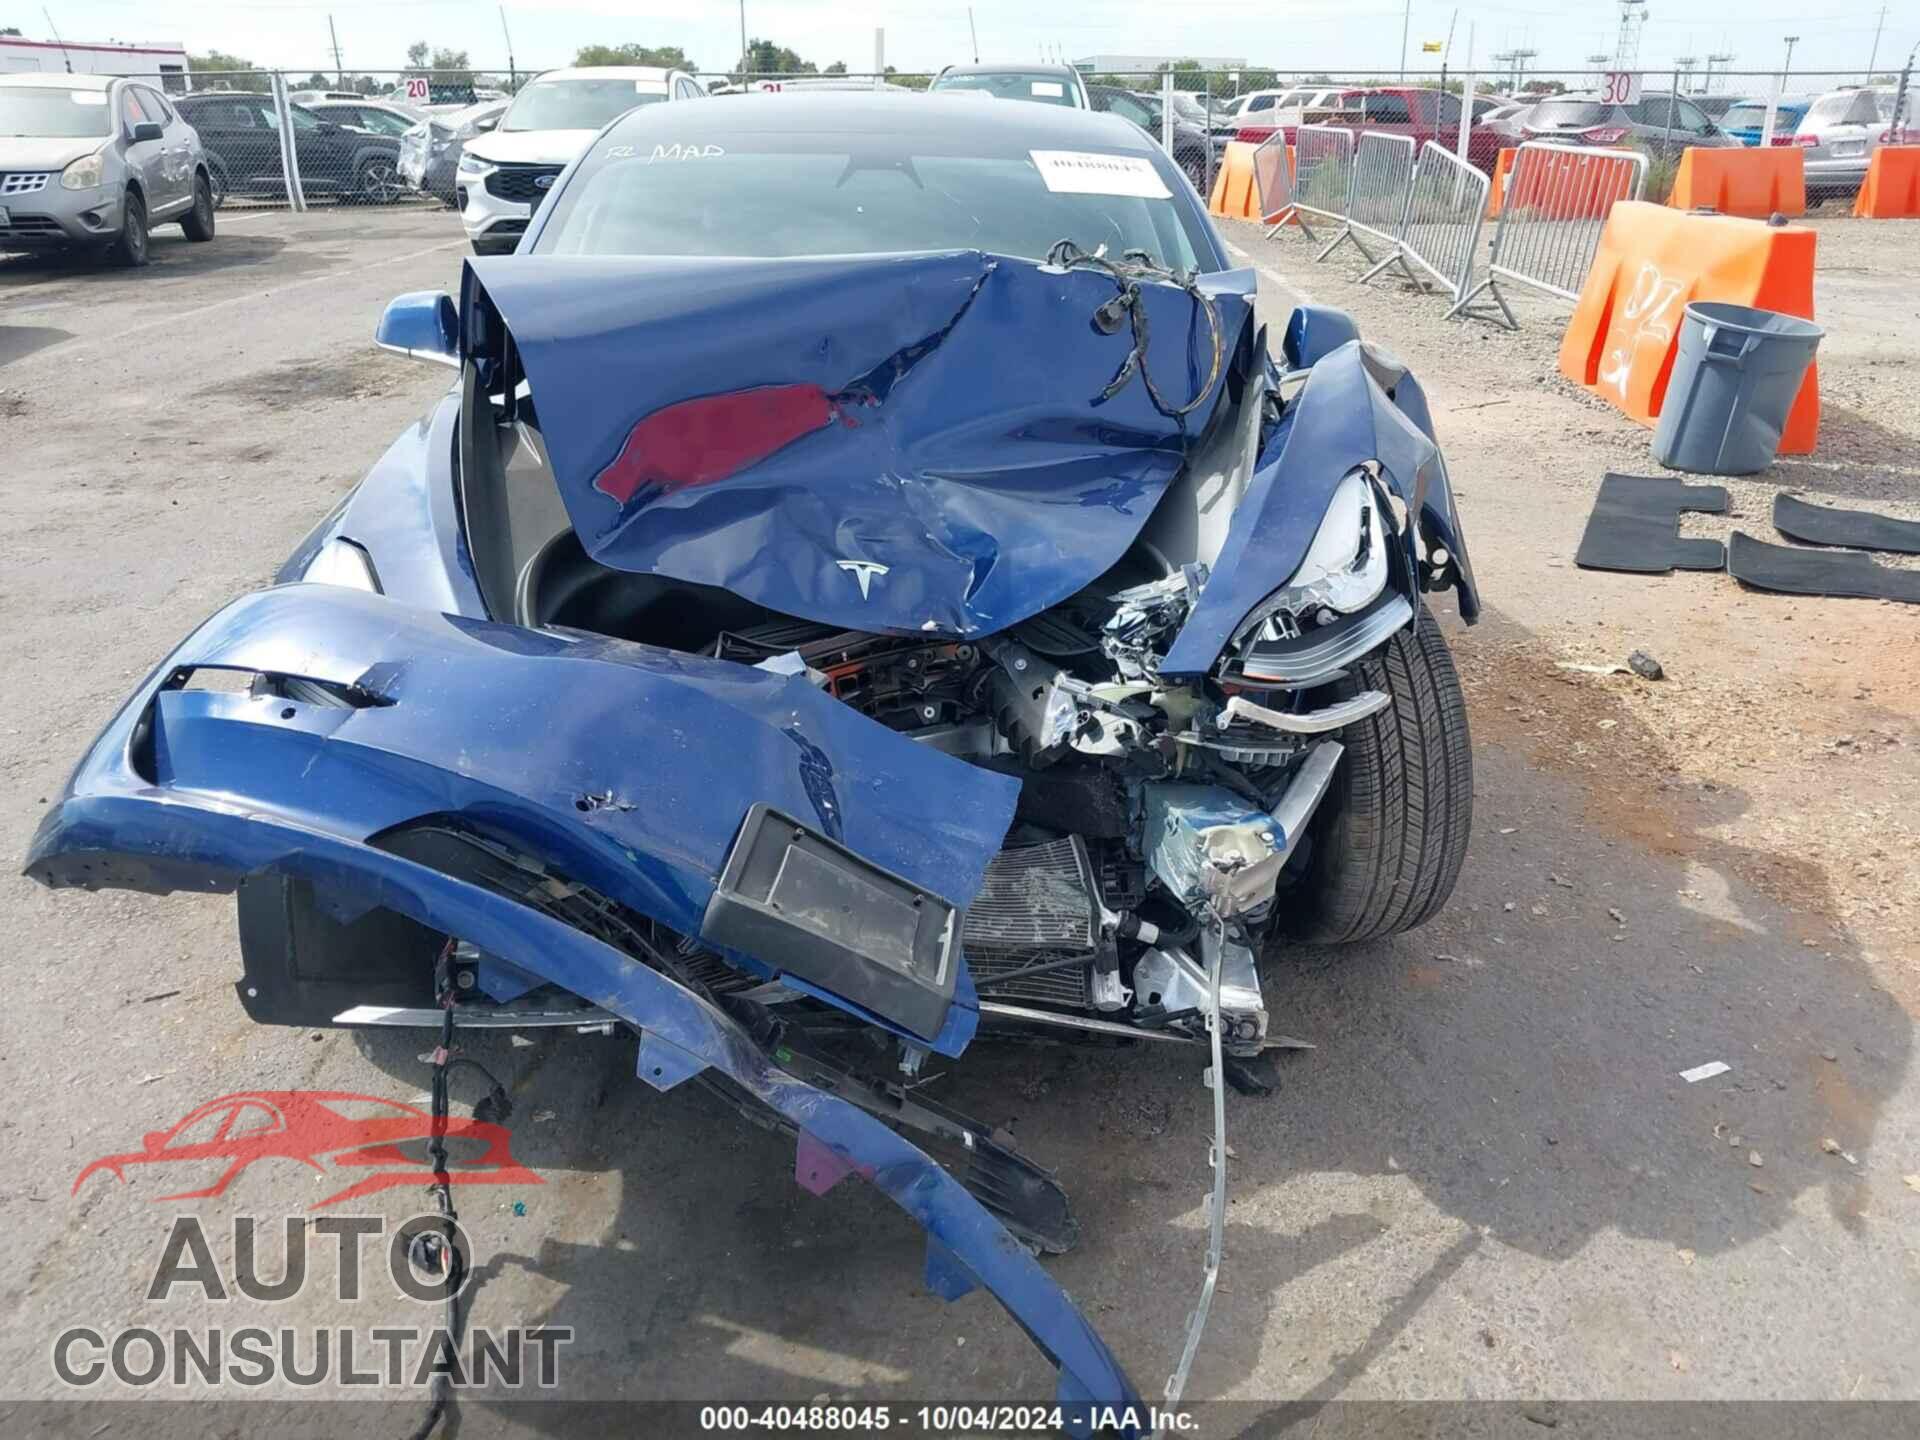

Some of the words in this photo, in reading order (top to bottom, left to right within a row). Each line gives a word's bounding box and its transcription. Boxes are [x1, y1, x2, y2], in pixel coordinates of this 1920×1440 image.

[407, 80, 426, 98] 20
[1601, 72, 1631, 104] 30
[647, 143, 726, 166] MAD
